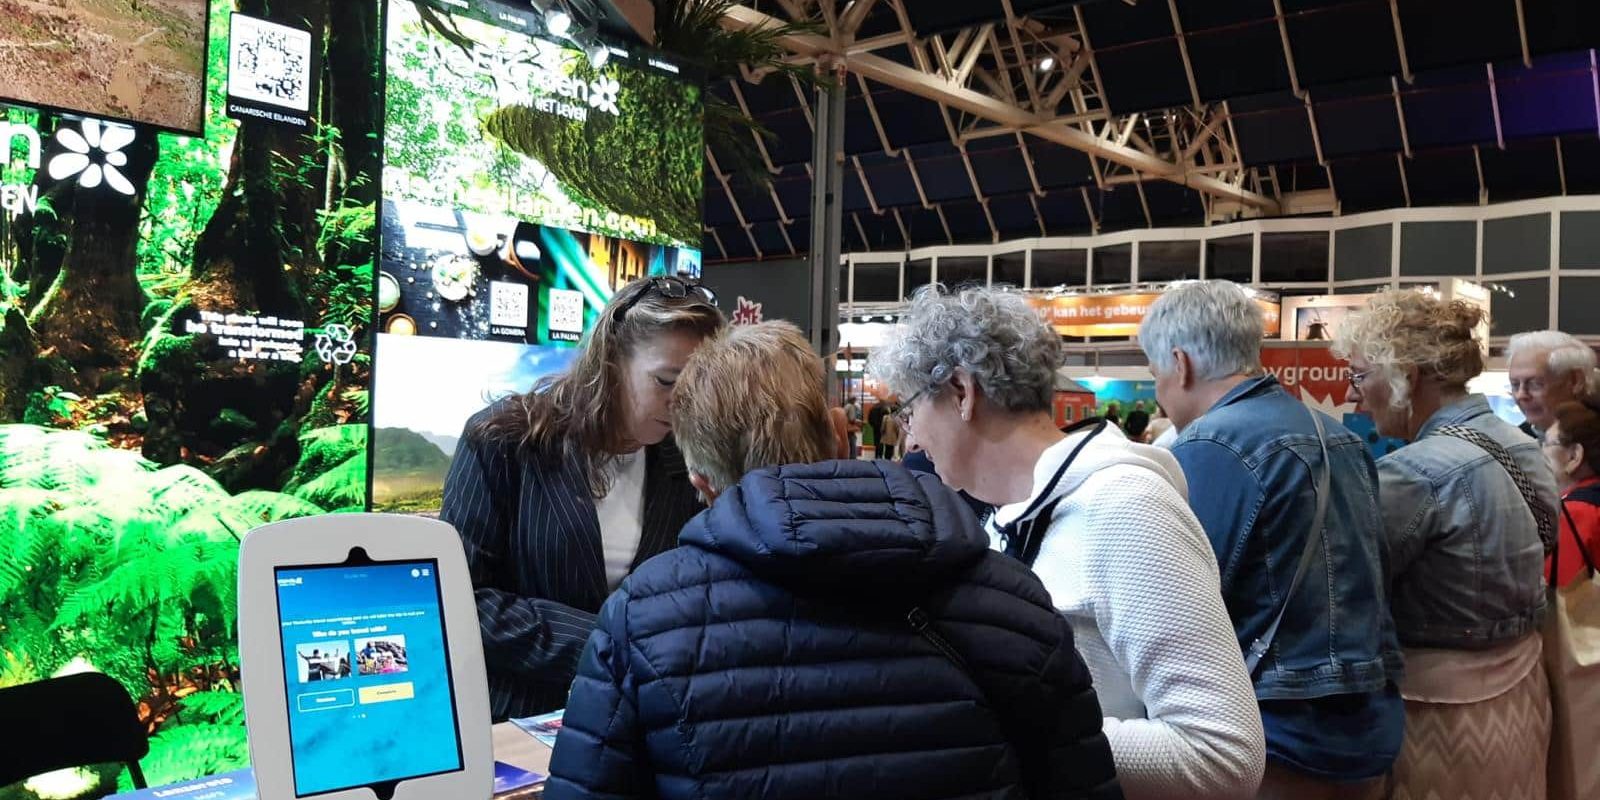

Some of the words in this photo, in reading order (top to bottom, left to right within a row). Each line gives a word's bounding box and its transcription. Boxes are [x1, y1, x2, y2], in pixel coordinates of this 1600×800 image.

[229, 104, 273, 120] CANARISCHE
[1053, 305, 1078, 318] kan
[1080, 304, 1104, 318] het
[185, 319, 208, 333] be
[210, 321, 304, 341] transformed
